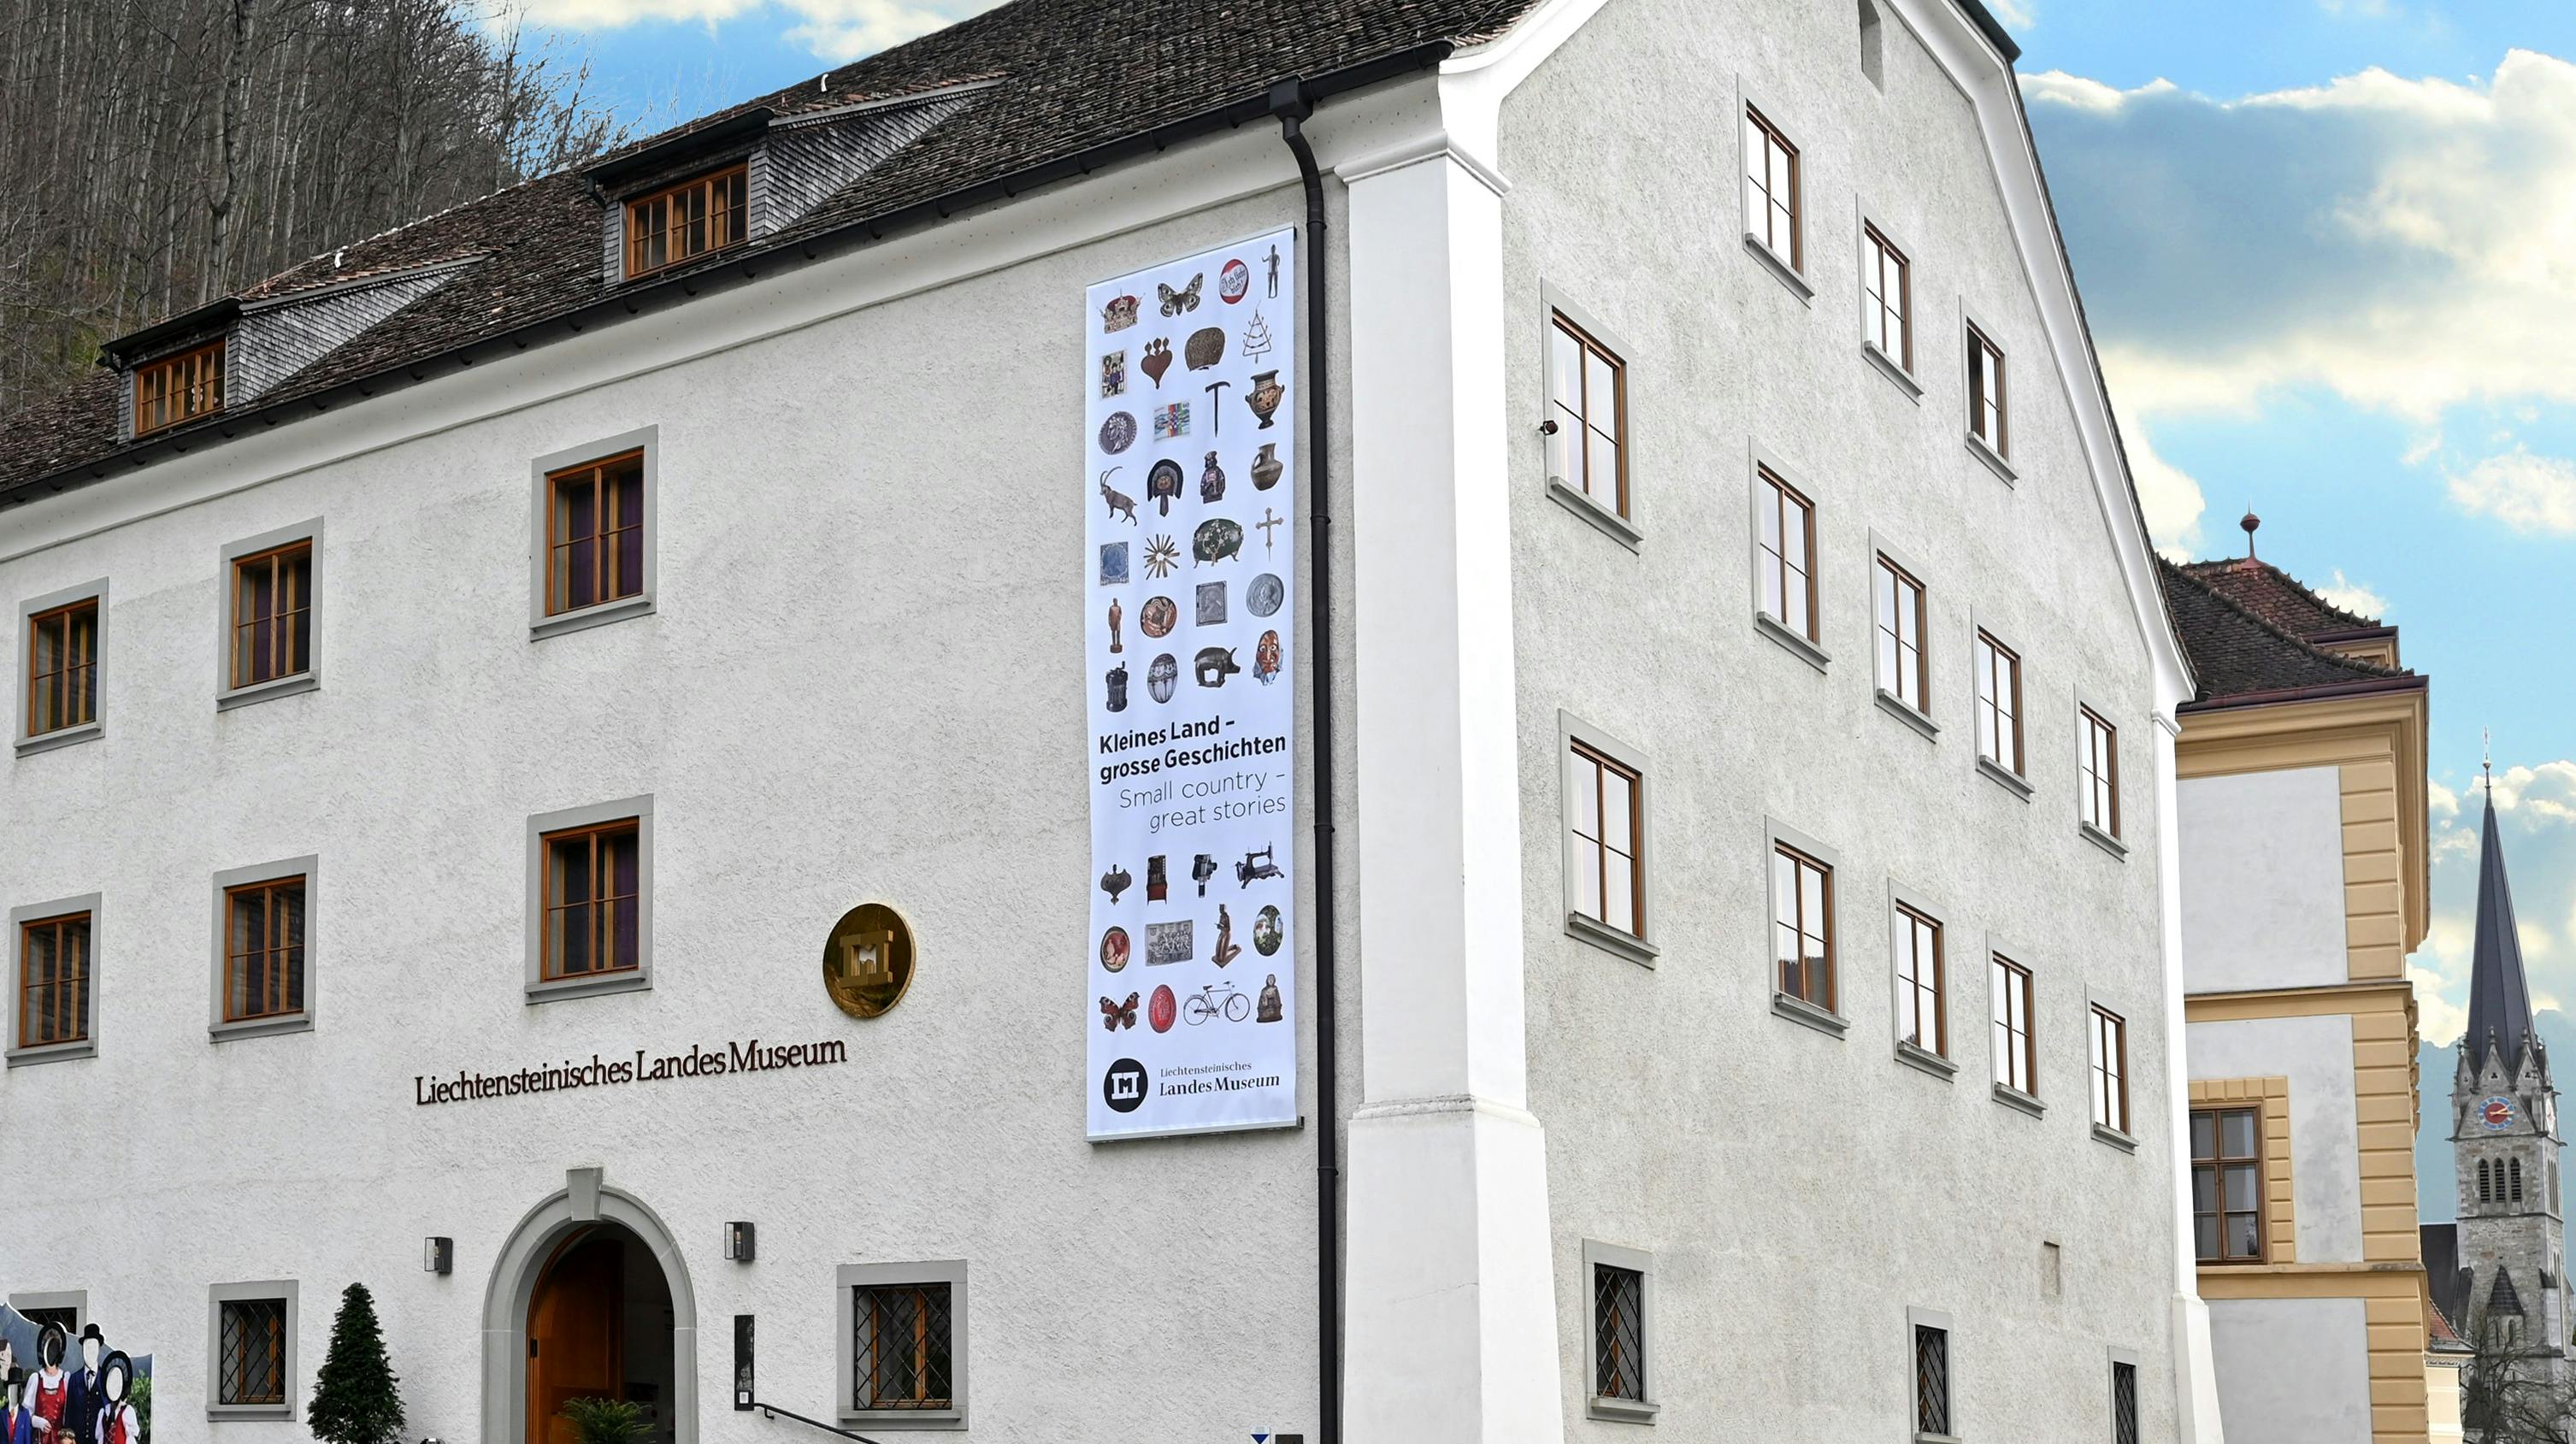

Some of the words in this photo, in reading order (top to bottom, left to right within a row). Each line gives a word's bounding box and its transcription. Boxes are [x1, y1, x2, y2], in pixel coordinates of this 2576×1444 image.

[1099, 728, 1166, 754] Kleines
[1170, 715, 1220, 740] Land
[1099, 757, 1161, 785] grosse
[1164, 735, 1286, 769] Geschichten
[1119, 780, 1173, 809] Small
[1182, 771, 1267, 799] country
[1149, 805, 1206, 834] great
[1212, 795, 1286, 822] stories
[415, 1053, 633, 1105] Liechtensteinisches
[1160, 1061, 1253, 1078] Liechtensteinisches
